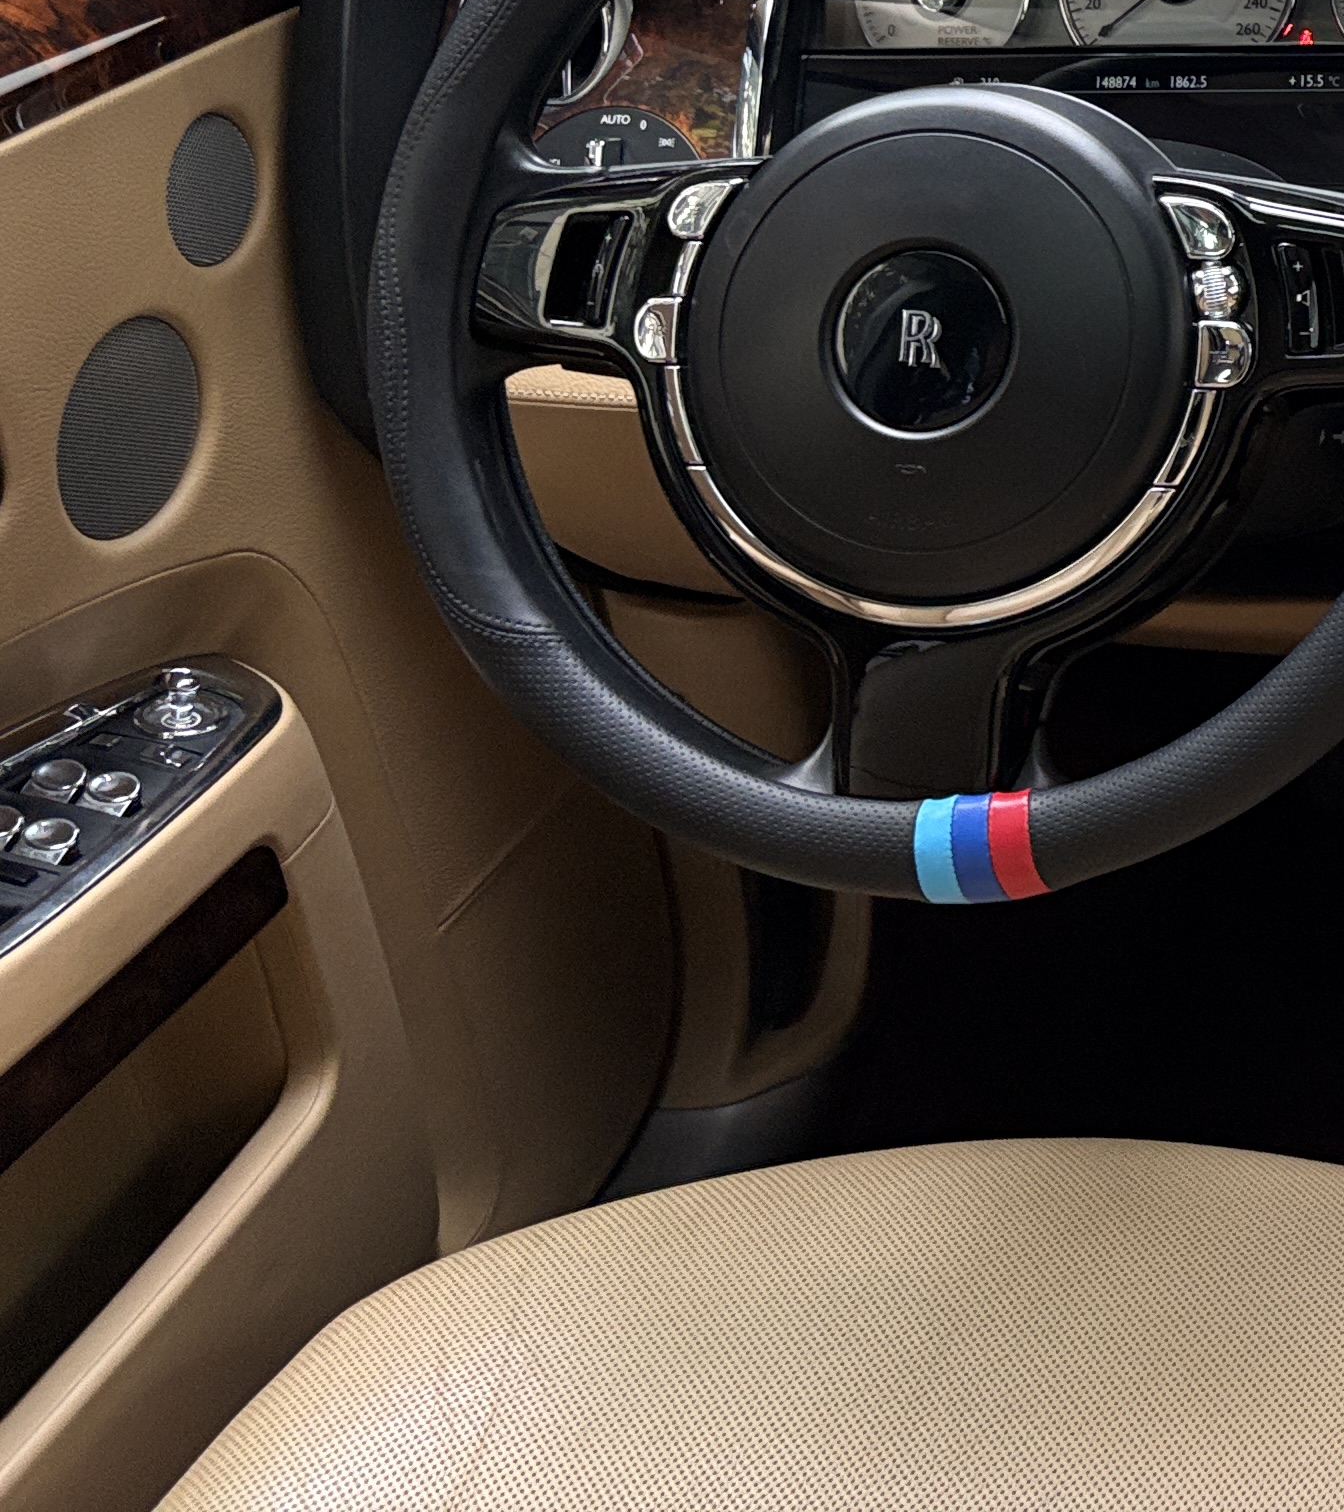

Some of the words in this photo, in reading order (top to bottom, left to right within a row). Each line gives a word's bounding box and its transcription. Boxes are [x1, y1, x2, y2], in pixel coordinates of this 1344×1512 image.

[888, 24, 896, 36] 0
[937, 26, 978, 35] POWER
[1236, 23, 1261, 36] 260
[937, 37, 980, 46] RESERVE
[1095, 76, 1137, 88] 148874
[1145, 78, 1160, 88] km
[1170, 76, 1208, 88] 1862.5
[600, 114, 631, 125] AUTO
